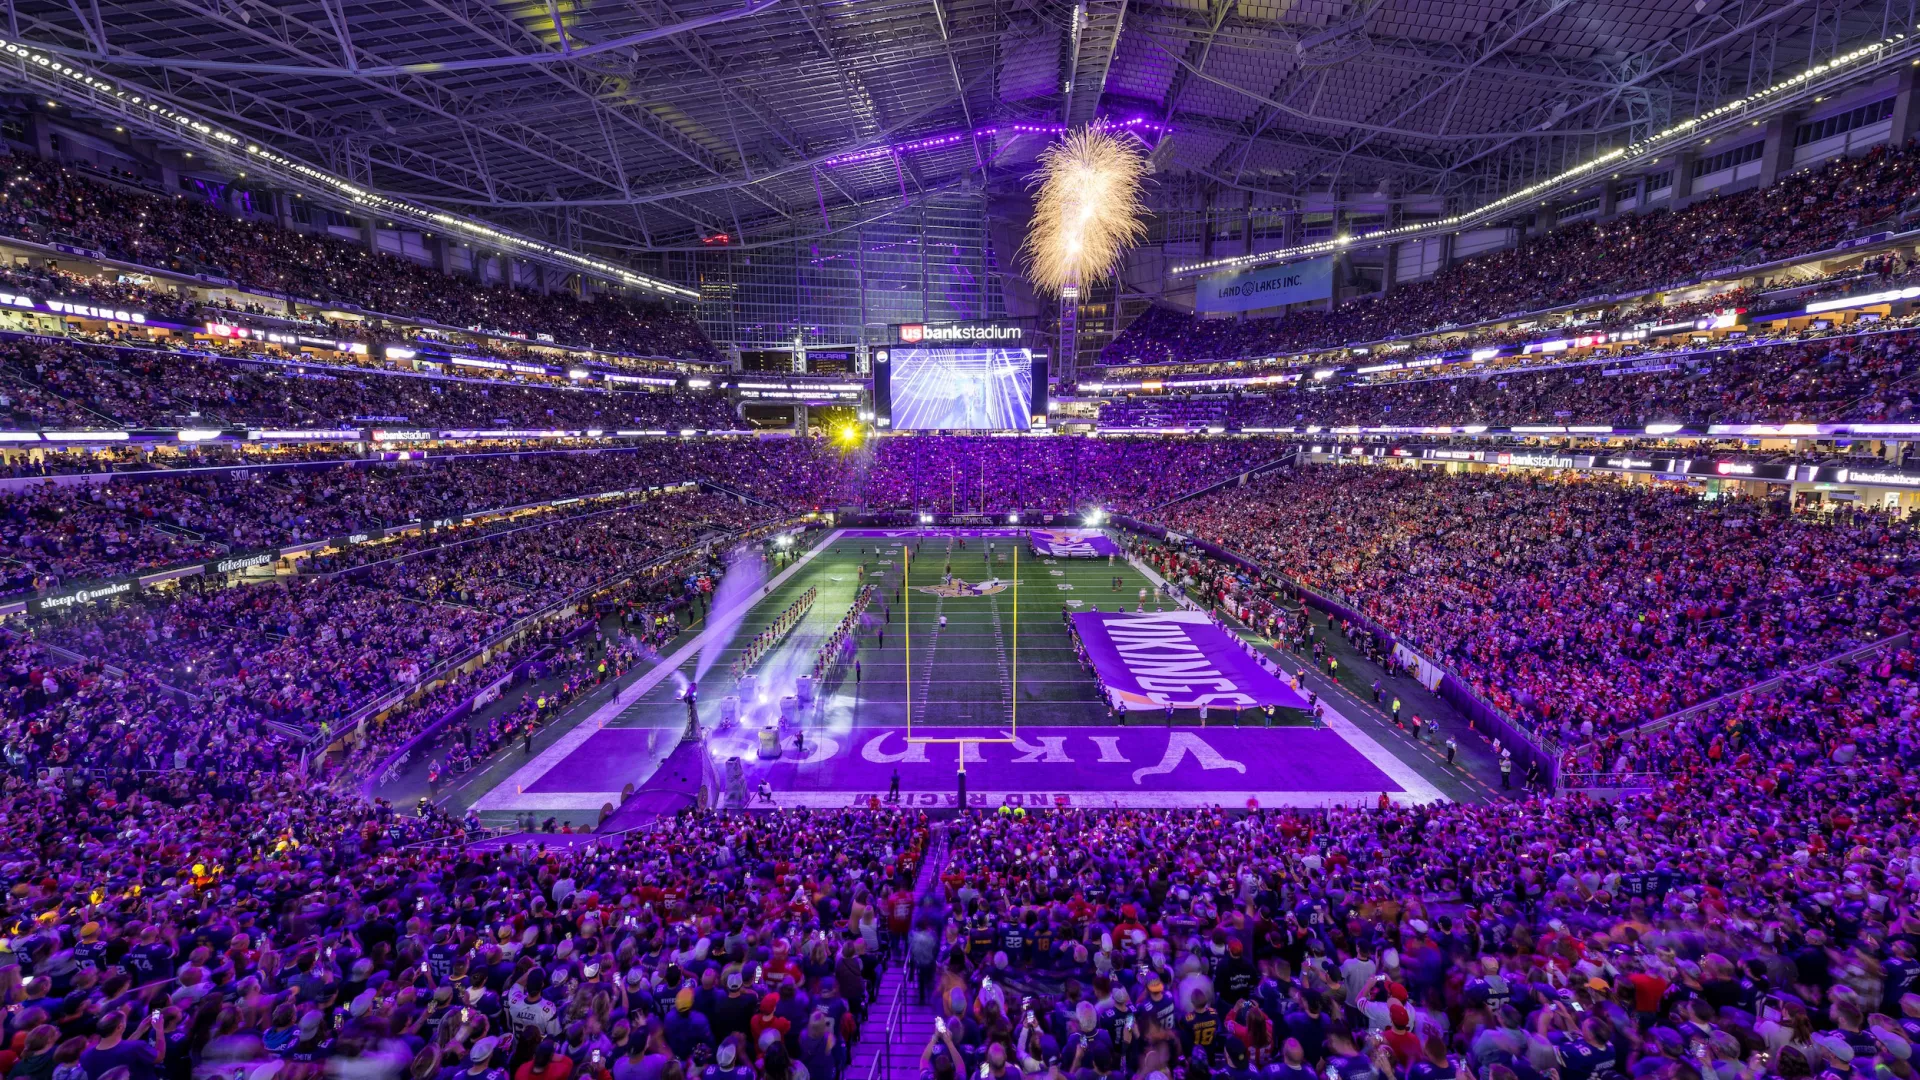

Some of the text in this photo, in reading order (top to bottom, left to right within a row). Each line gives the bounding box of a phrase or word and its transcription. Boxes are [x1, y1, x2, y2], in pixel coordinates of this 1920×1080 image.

[1854, 237, 1871, 246] GRANT
[1218, 286, 1241, 298] LAND
[1283, 275, 1302, 287] INC.
[46, 301, 146, 323] VIKINGS
[217, 552, 273, 573] ticketmaster
[40, 582, 132, 609] sleep number
[1102, 618, 1258, 706] VIKINGS
[1631, 883, 1642, 893] 19
[1005, 936, 1023, 949] 22
[1038, 938, 1050, 951] 18
[516, 1011, 536, 1021] ALLEN
[1193, 1028, 1216, 1046] 18
